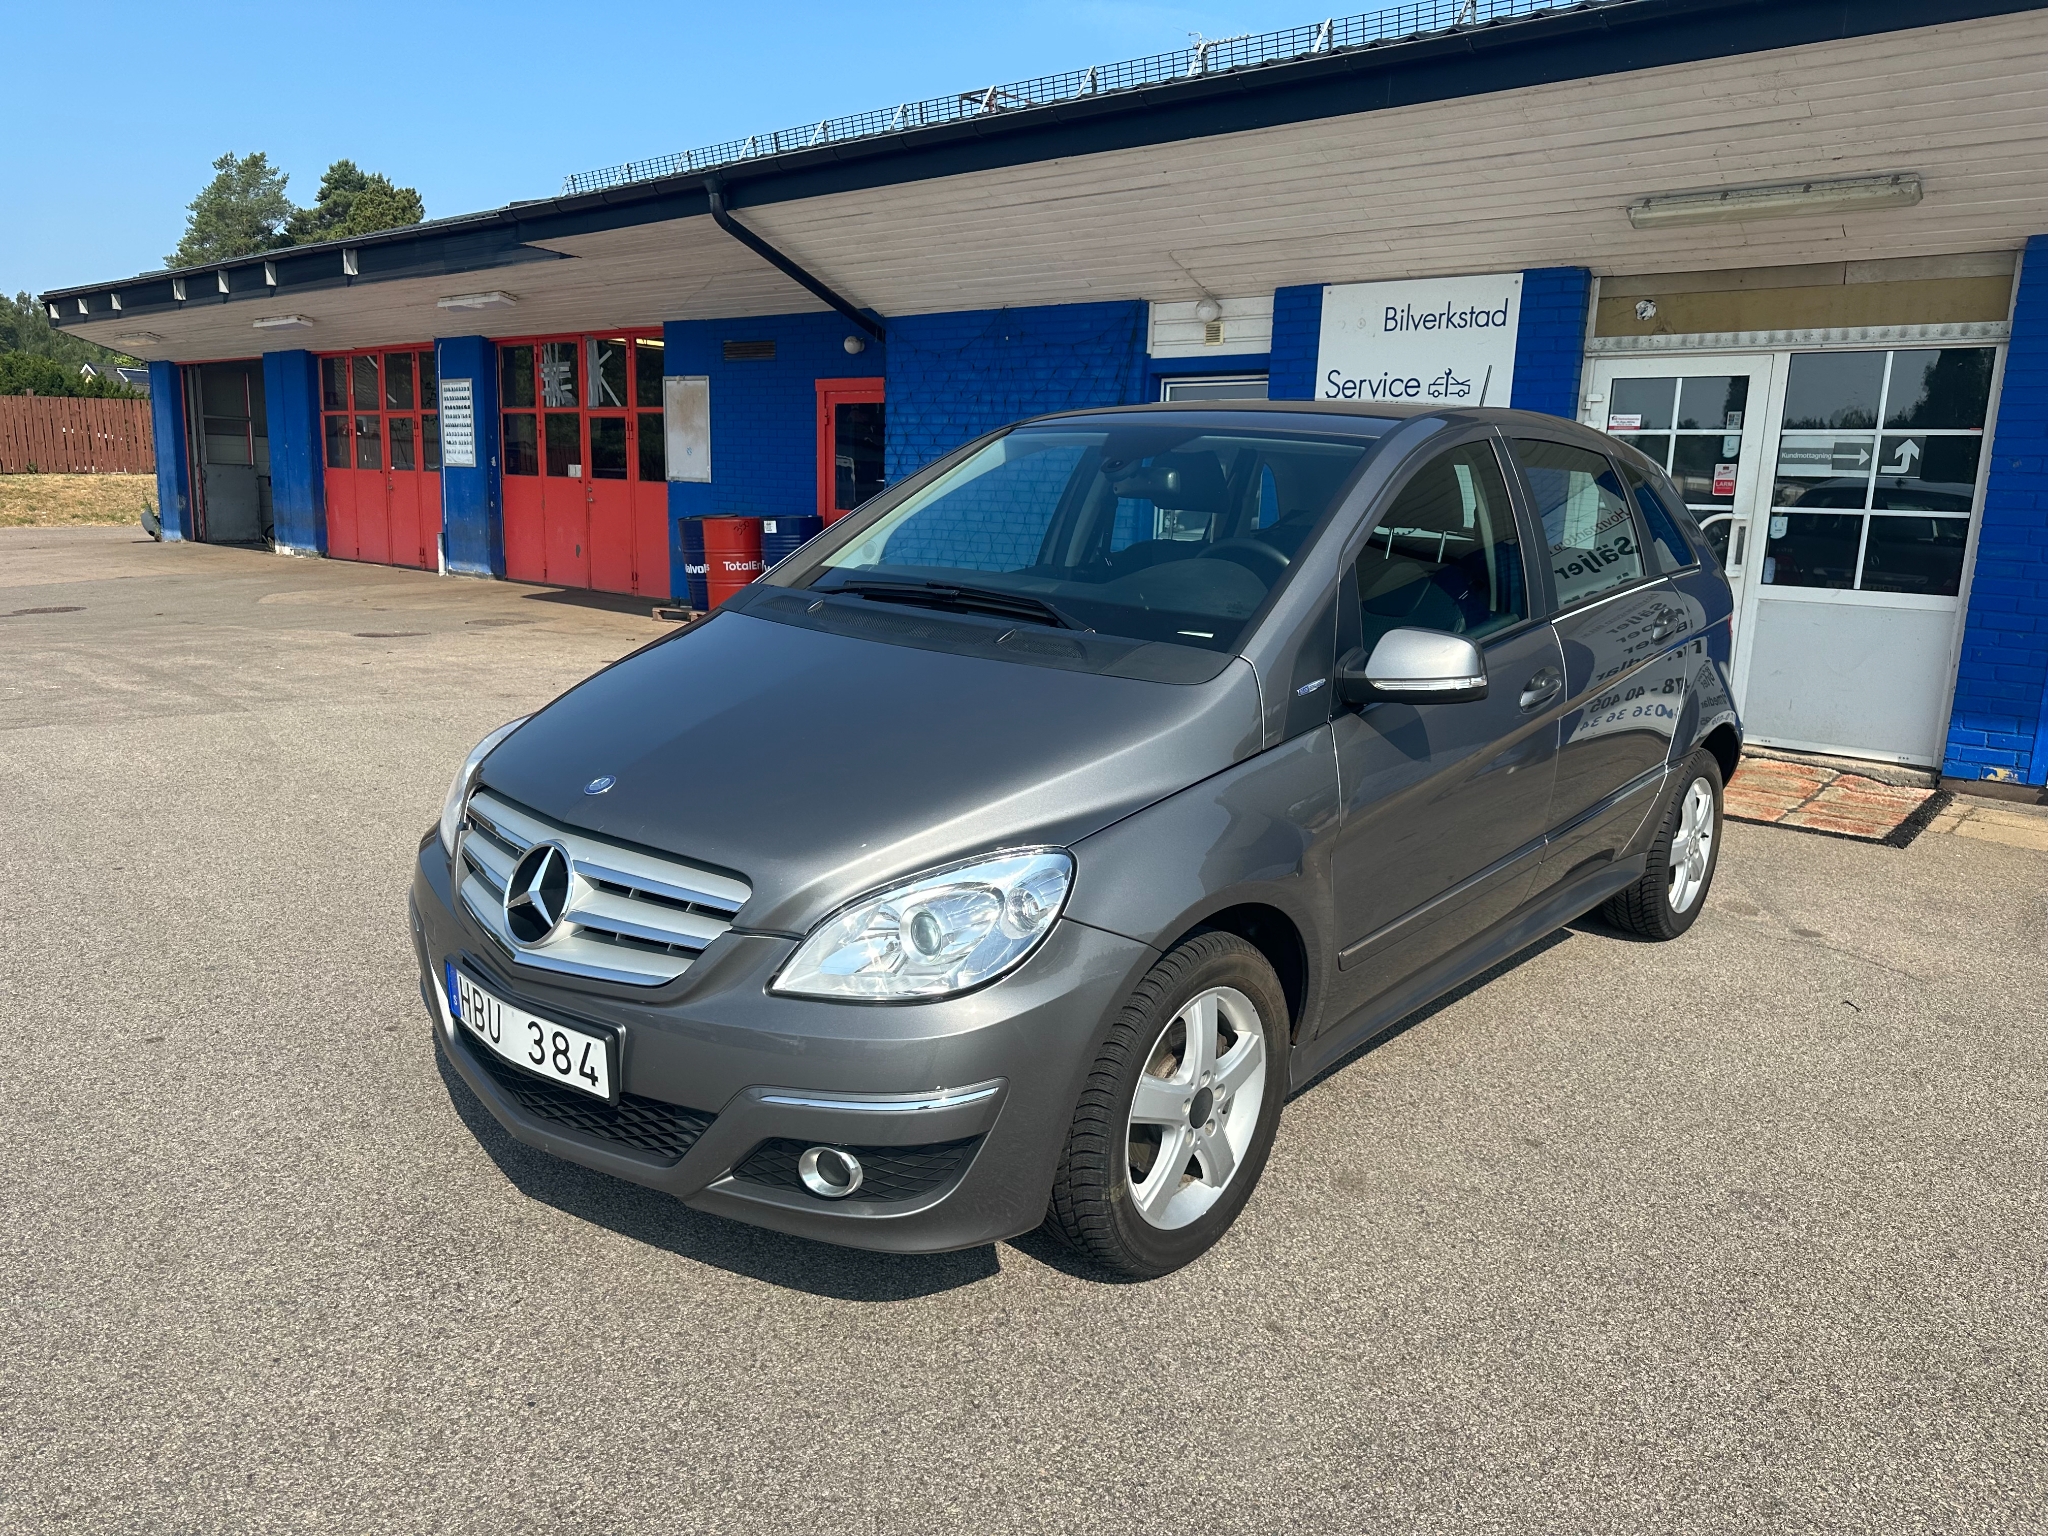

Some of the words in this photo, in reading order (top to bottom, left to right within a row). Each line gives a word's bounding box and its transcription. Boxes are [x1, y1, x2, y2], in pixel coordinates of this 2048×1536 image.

[1383, 298, 1509, 332] Bilverkstad
[1325, 369, 1421, 399] Service
[1781, 452, 1832, 460] Kundmottagning
[733, 520, 750, 536] 350
[458, 974, 501, 1044] HBU
[527, 1020, 599, 1087] 384
